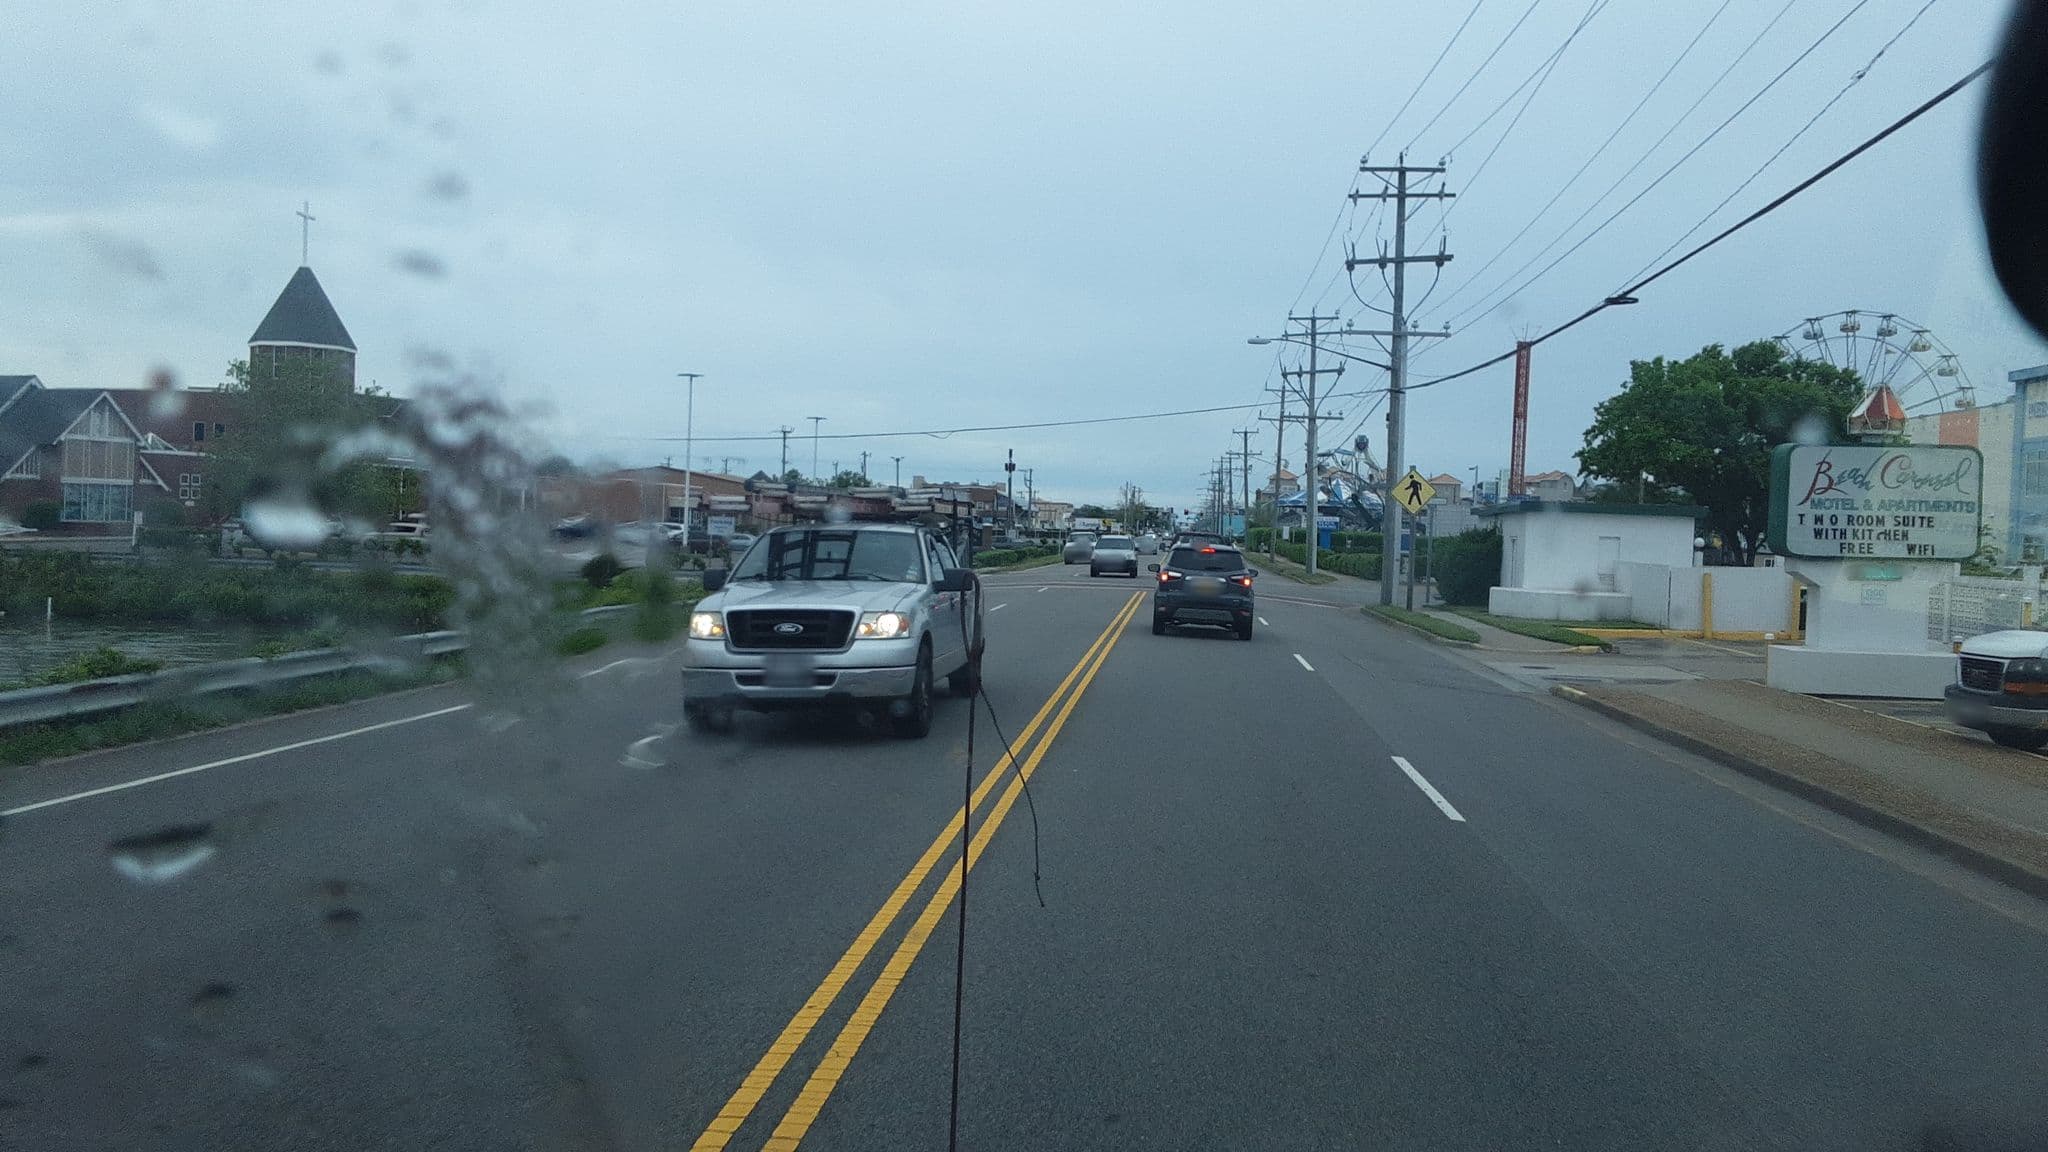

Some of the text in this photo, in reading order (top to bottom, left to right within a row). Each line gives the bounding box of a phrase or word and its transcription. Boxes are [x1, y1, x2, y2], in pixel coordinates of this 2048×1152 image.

[1810, 498, 1976, 514] MOTEL & APARTMENTS
[1846, 515, 1885, 528] ROOM
[1894, 516, 1935, 529] SUITE
[1813, 528, 1847, 540] WITH
[1839, 542, 1935, 556] FREE WIFI
